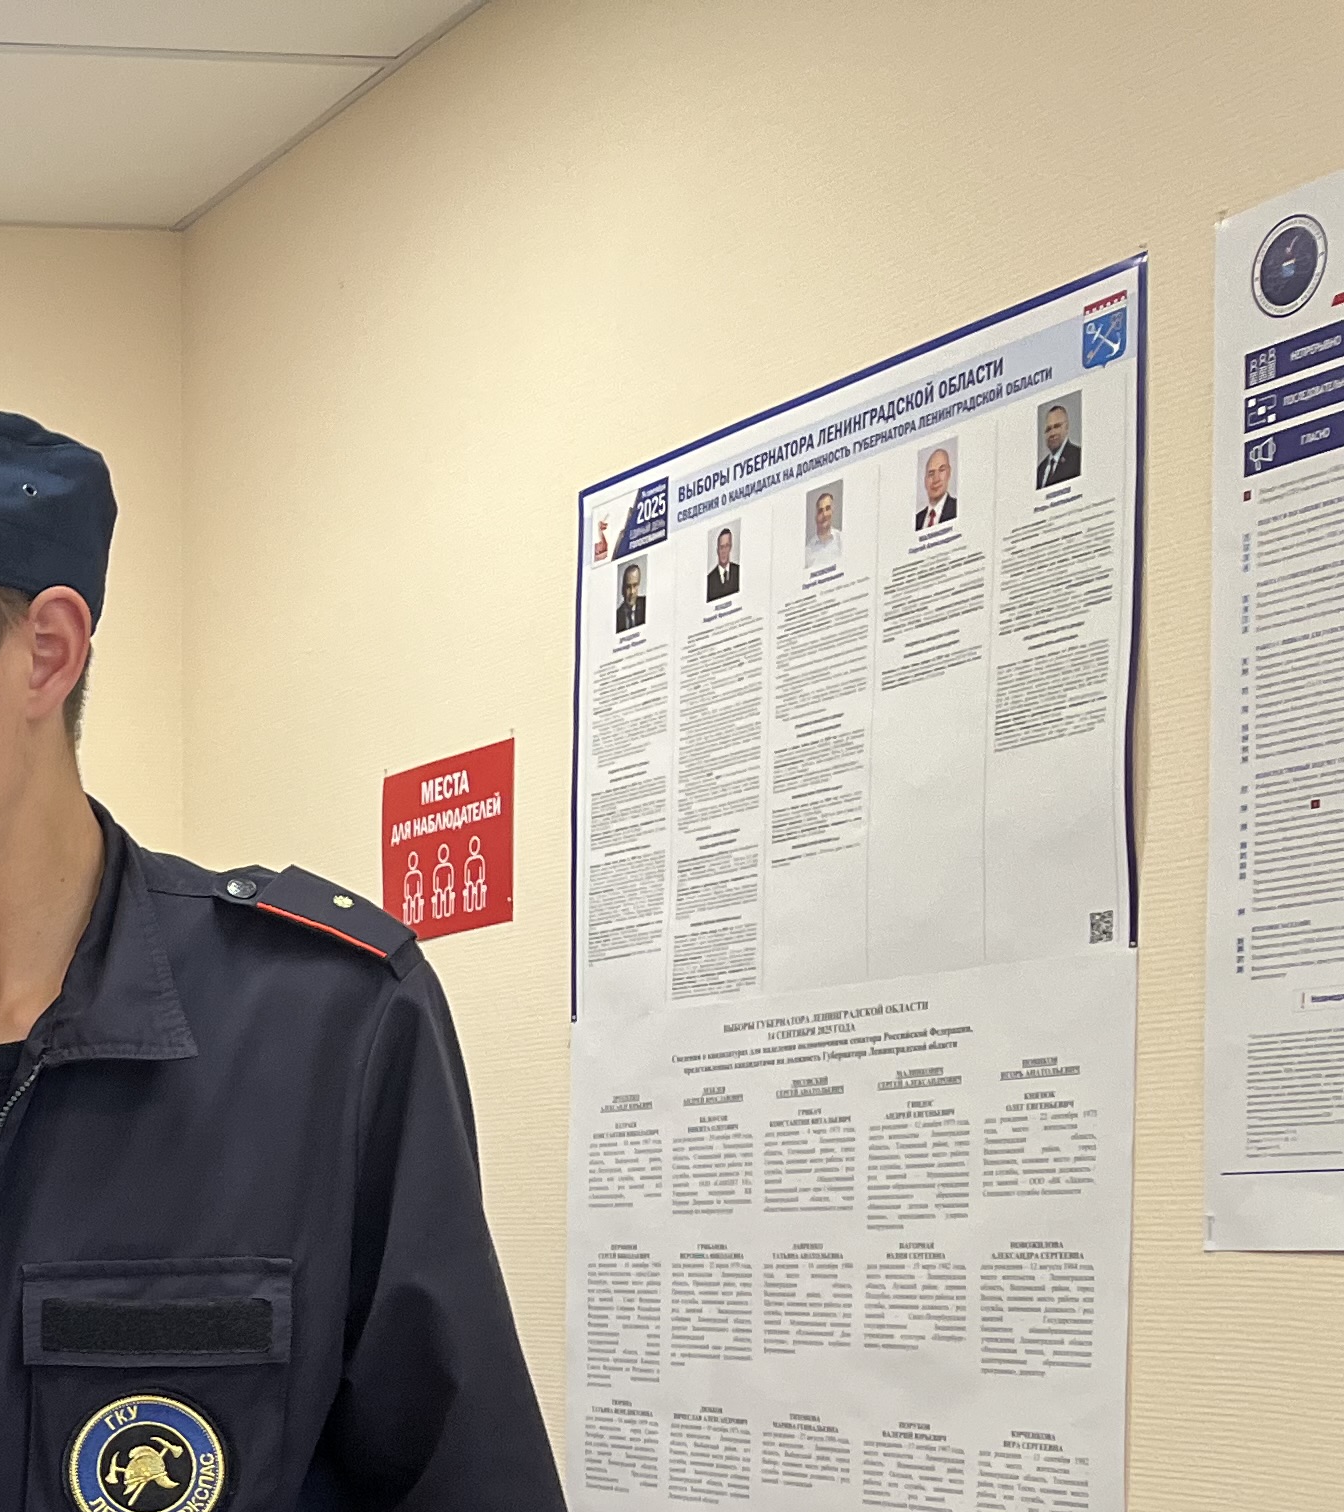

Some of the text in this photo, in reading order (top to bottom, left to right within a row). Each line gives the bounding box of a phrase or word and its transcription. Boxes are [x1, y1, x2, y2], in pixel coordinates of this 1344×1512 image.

[677, 366, 1053, 523] СВЕДЕНИЯ О КАНДИДАТАХ НА ДОЛЖНОСТЬ ГУБЕРНАТОРА ЛЕНИНГРАДСКОЙ ОБЛАСТИ
[678, 356, 1004, 503] ВЫБОРЫ ГУБЕРНАТОРА ЛЕНИНГРАДСКОЙ ОБЛАСТИ
[636, 493, 665, 525] 2025
[421, 770, 469, 805] МЕСТА
[391, 791, 501, 847] ДЛЯ НАБЛЮДАТЕЛЕЙ
[104, 1405, 138, 1431] ГКУ
